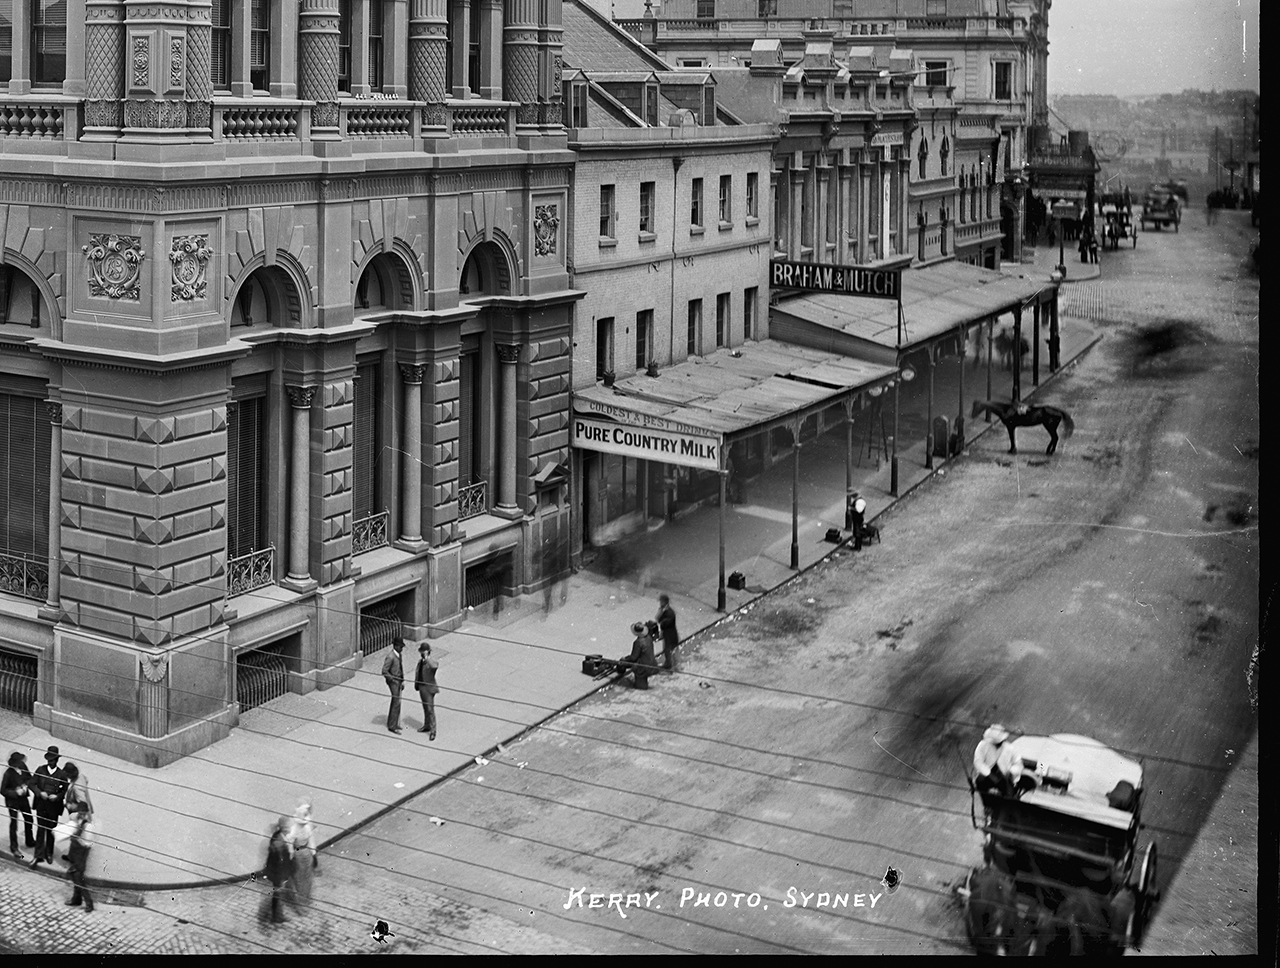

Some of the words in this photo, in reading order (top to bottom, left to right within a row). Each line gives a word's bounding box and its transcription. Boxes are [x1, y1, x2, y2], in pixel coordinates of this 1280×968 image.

[773, 263, 833, 290] BRAHAM
[834, 271, 843, 288] &
[843, 269, 894, 295] MUTCH
[589, 401, 631, 420] COLDEST
[633, 414, 641, 424] &
[643, 415, 672, 429] BEST
